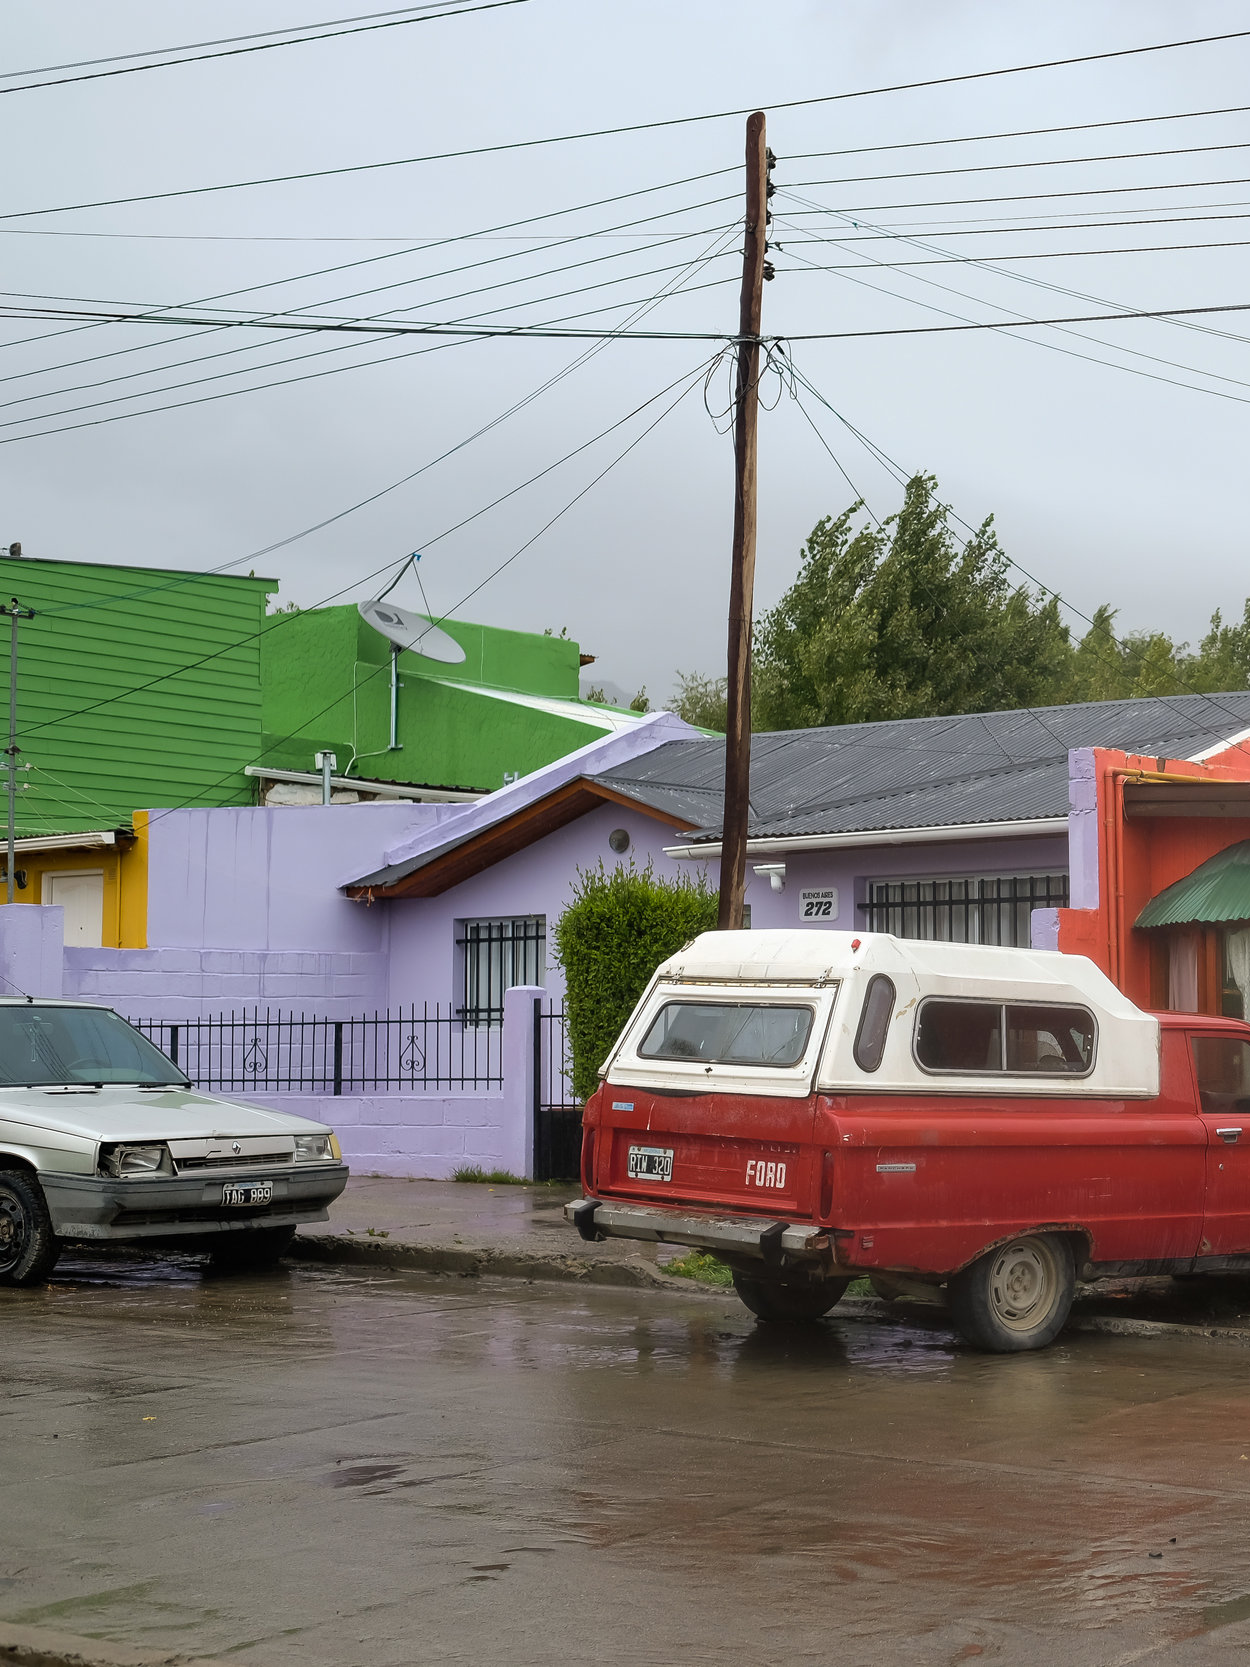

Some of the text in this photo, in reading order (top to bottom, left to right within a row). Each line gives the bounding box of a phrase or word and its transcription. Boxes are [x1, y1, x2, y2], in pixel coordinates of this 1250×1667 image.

[804, 901, 833, 916] 272
[629, 1154, 670, 1175] RIW 320
[745, 1160, 786, 1188] FORD
[225, 1188, 270, 1204] TAG 889
